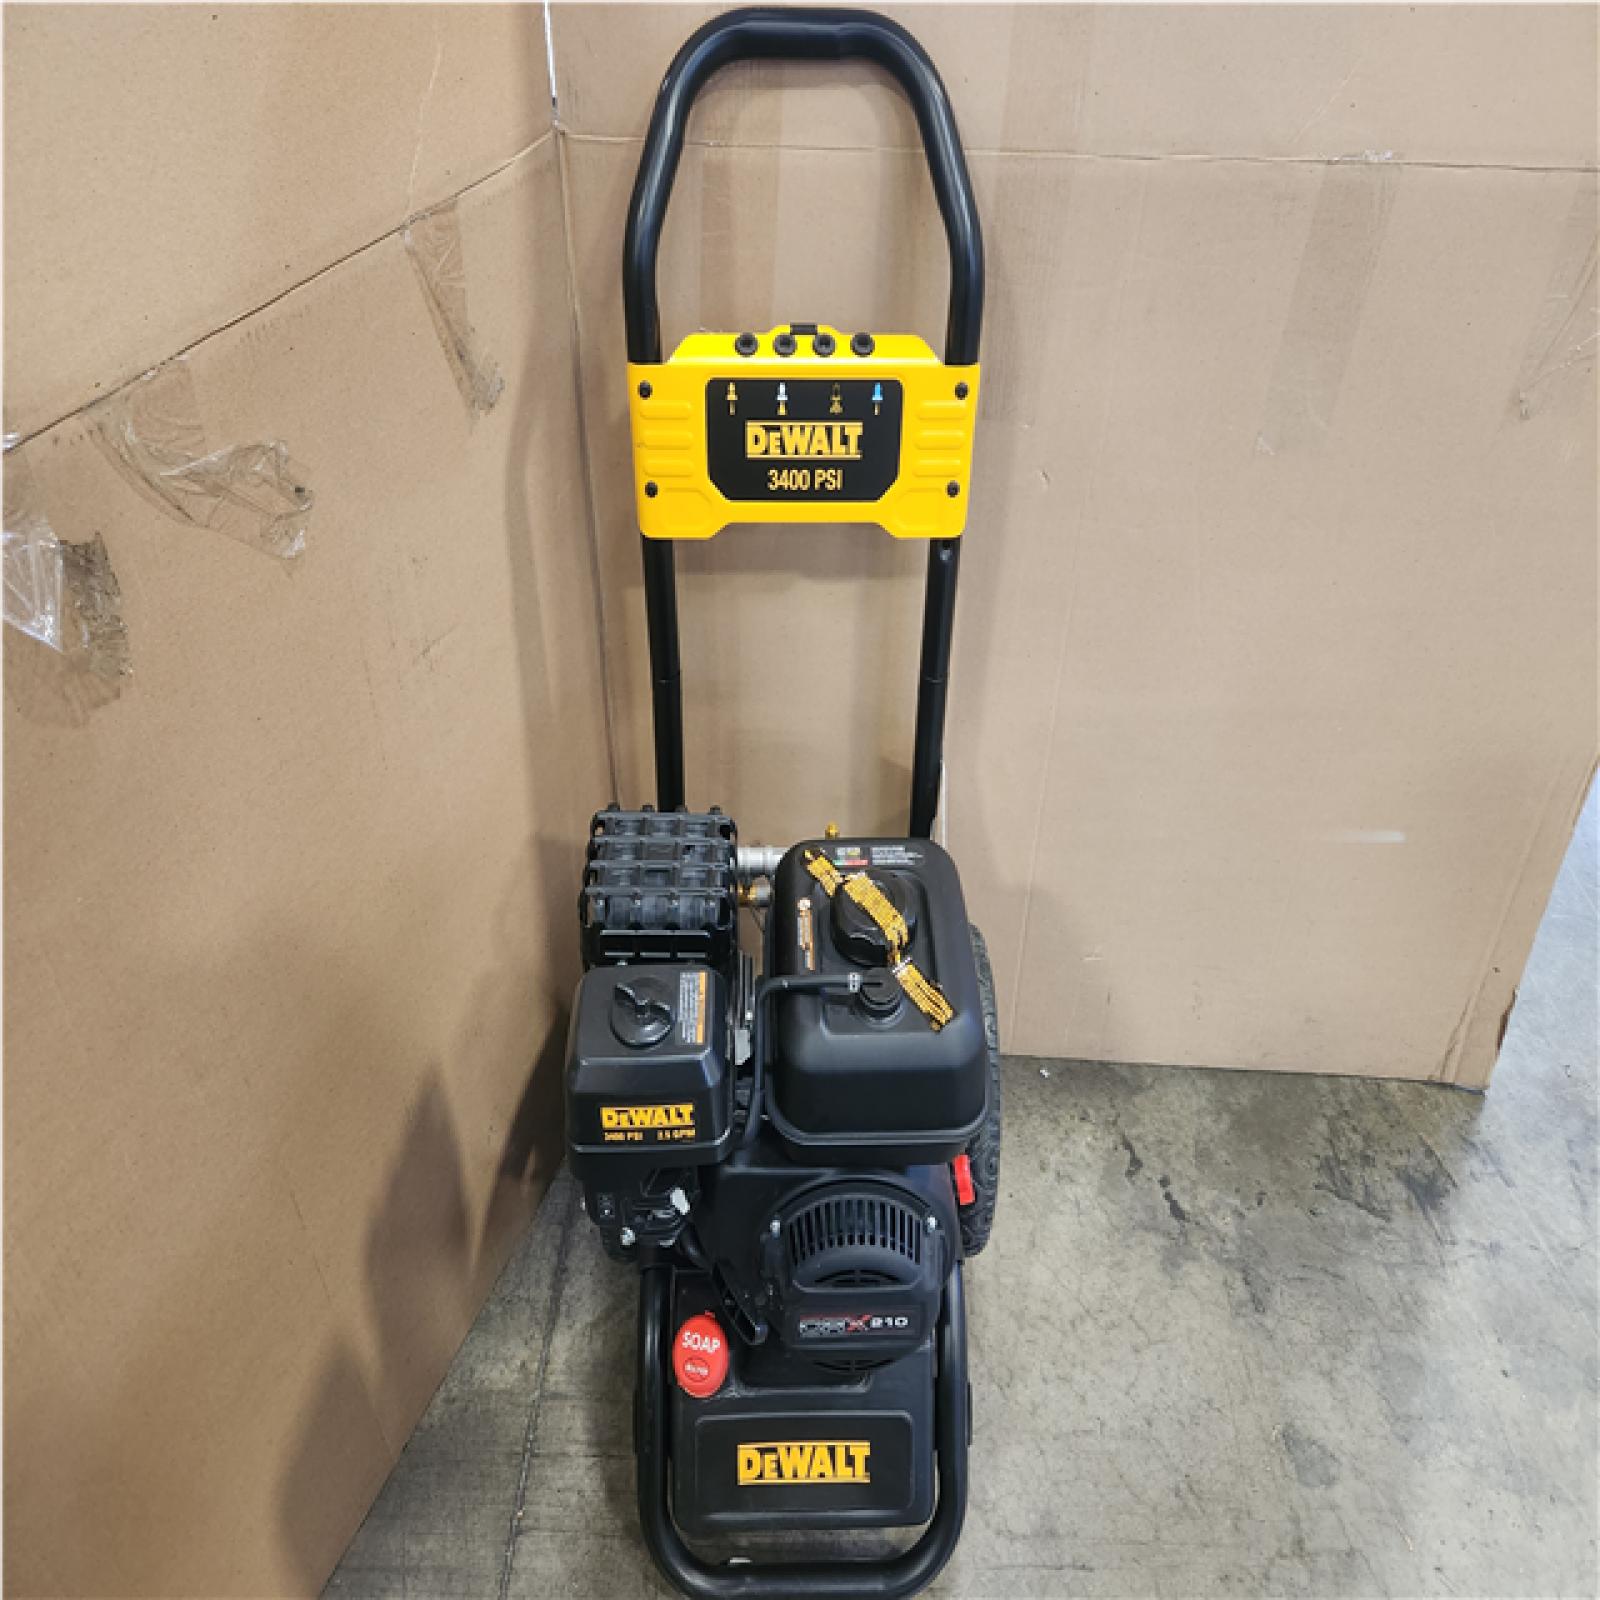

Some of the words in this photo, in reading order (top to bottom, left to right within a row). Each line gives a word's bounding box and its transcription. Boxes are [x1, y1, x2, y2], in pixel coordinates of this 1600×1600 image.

[745, 421, 863, 460] DEWALT
[768, 469, 809, 491] 3400
[815, 469, 843, 491] PSI
[601, 1103, 695, 1129] DEWALT
[681, 1329, 721, 1354] SOAP
[737, 1440, 871, 1486] DEWALT
